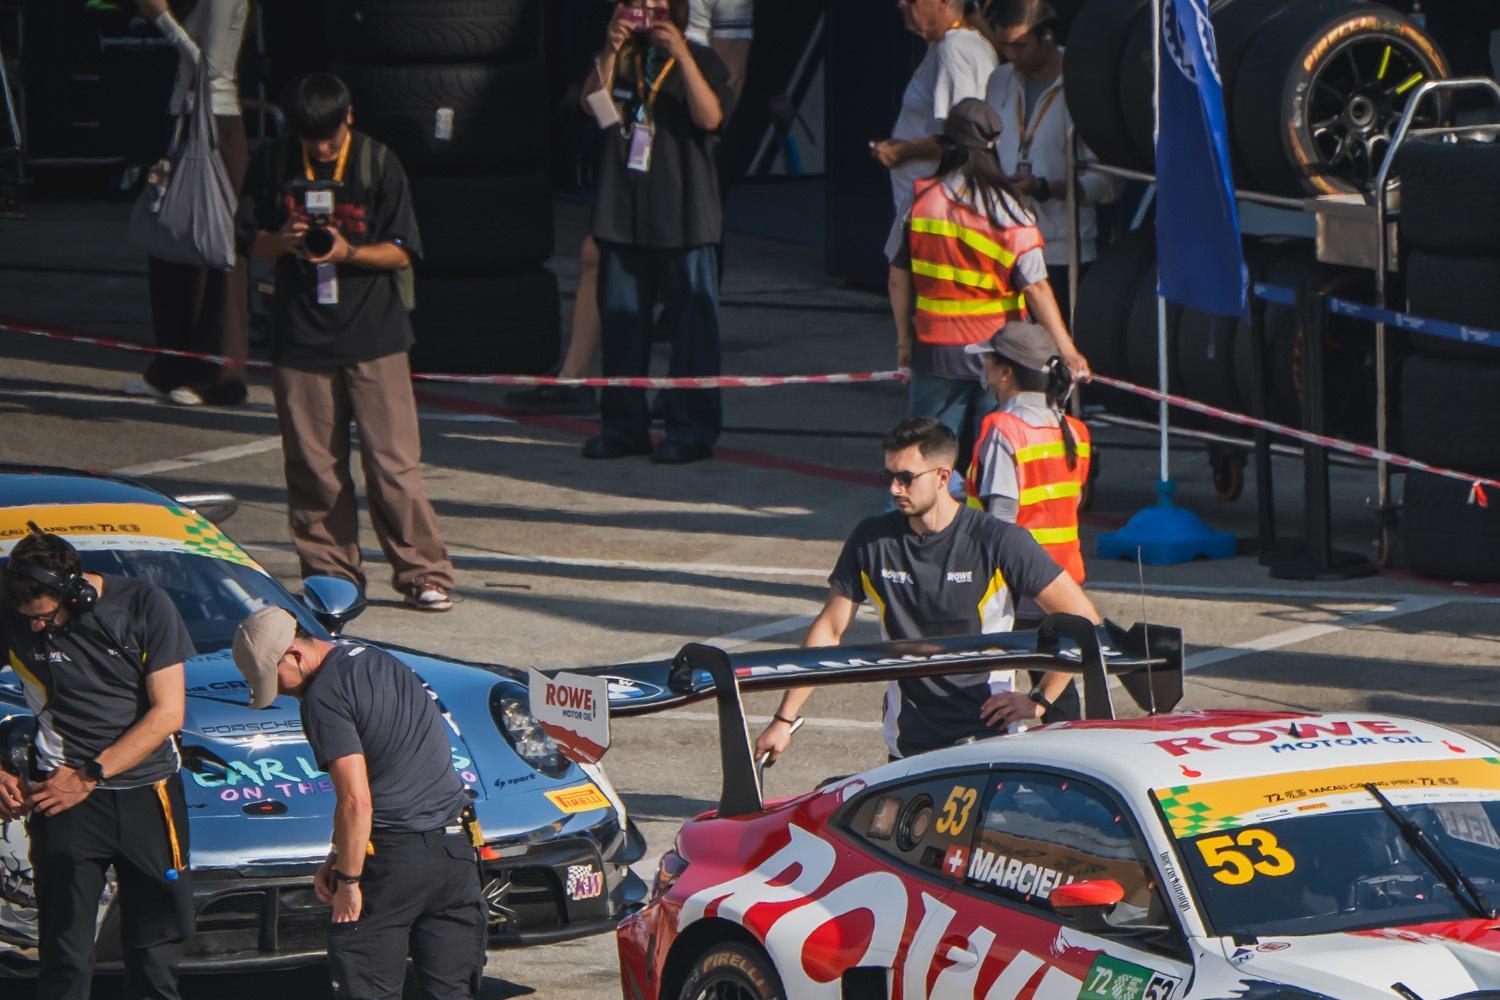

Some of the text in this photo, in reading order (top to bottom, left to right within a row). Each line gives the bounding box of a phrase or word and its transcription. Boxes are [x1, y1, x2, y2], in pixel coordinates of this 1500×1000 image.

[545, 683, 593, 711] ROWE
[1153, 720, 1413, 758] ROWE
[1270, 733, 1433, 754] MOTOR OIL
[220, 782, 263, 801] ON
[1264, 794, 1285, 804] 72
[1416, 777, 1436, 786] 72
[936, 785, 977, 836] 53
[1196, 828, 1295, 885] 53
[703, 952, 765, 988] PIRELLI
[1087, 966, 1113, 996] 72
